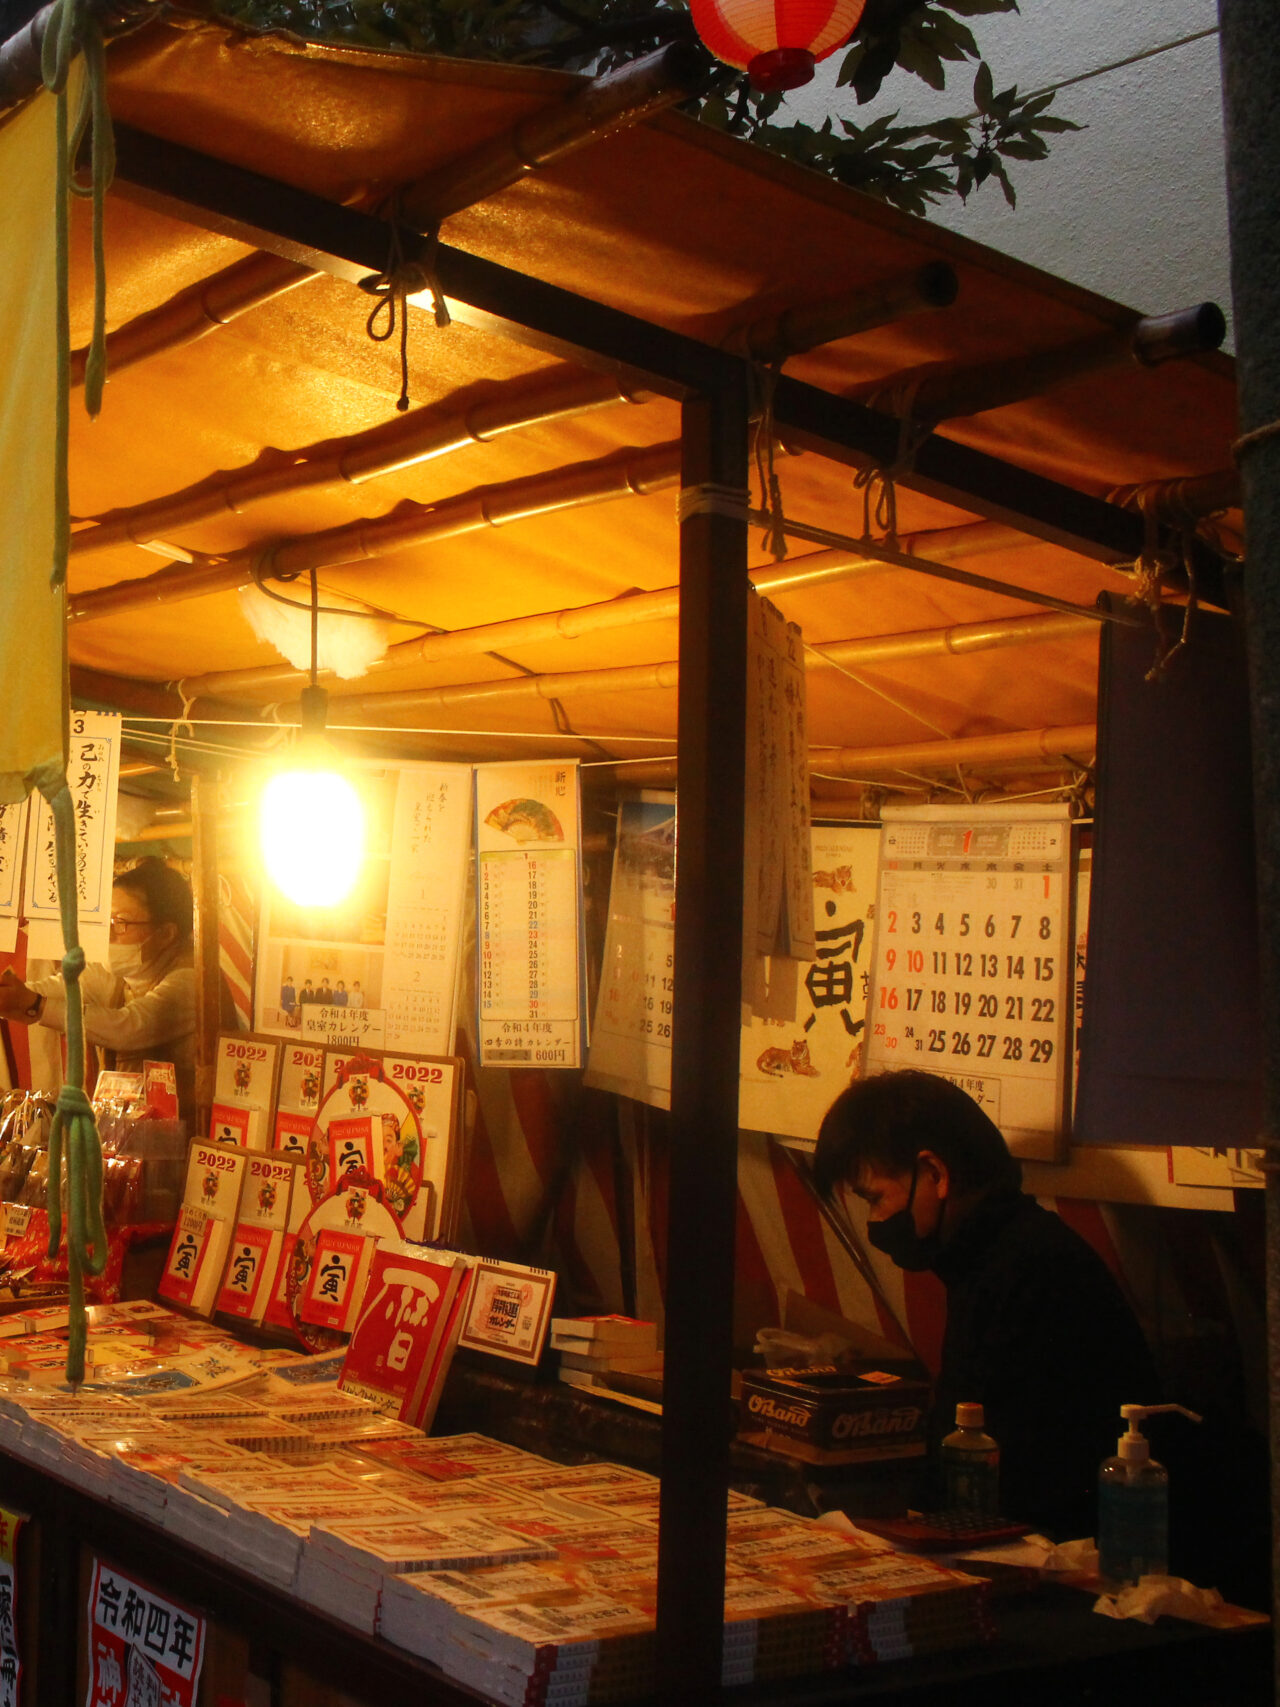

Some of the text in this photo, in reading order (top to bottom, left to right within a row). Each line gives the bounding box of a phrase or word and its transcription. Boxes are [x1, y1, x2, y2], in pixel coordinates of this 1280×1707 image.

[963, 830, 973, 852] 1
[484, 861, 537, 870] 1 16
[484, 871, 537, 880] 2 17
[484, 881, 537, 890] 3 18
[986, 875, 1050, 898] 30 31 1
[484, 891, 537, 900] 4 19
[485, 901, 537, 910] 5 20
[485, 911, 537, 920] 6 21
[485, 921, 537, 930] 7 22
[888, 911, 1051, 939] 2 3 4 5 6 7 8
[485, 931, 537, 939] 8 23
[485, 941, 537, 949] 9 24
[483, 950, 538, 959] 10 25
[483, 960, 538, 969] 11 26
[887, 949, 1054, 981] 9 10 11 12 13 14 15
[483, 970, 538, 979] 12 27
[483, 980, 538, 989] 13 28
[662, 977, 673, 991] 12
[483, 990, 538, 998] 14 29
[484, 1000, 538, 1008] 15 30
[660, 1000, 672, 1014] 19
[880, 987, 1054, 1022] 16 17 18 19 20 21 22
[320, 1007, 369, 1021] 令和4年度
[529, 1010, 538, 1018] 31
[307, 1019, 382, 1033] 皇室カレンダー
[502, 1022, 552, 1033] 令和4年度
[640, 1019, 670, 1037] 25 26
[327, 1034, 360, 1047] 1800円
[484, 1037, 570, 1047] 四季の詩 カレンダー
[874, 1024, 1053, 1063] 23 30 24 31 25 26 27 28 29
[226, 1043, 267, 1062] 2022
[292, 1051, 324, 1068] 202
[535, 1049, 565, 1061] 600円
[392, 1064, 443, 1084] 2022
[942, 1076, 984, 1092] 和4年度
[197, 1151, 237, 1173] 2022
[250, 1161, 293, 1181] 2022
[176, 1234, 198, 1279] 寅
[233, 1247, 256, 1292] 寅
[319, 1255, 347, 1302] 寅
[491, 1298, 519, 1318] 開運
[489, 1315, 516, 1329] カレンダー
[99, 1578, 195, 1668] 令和四年
